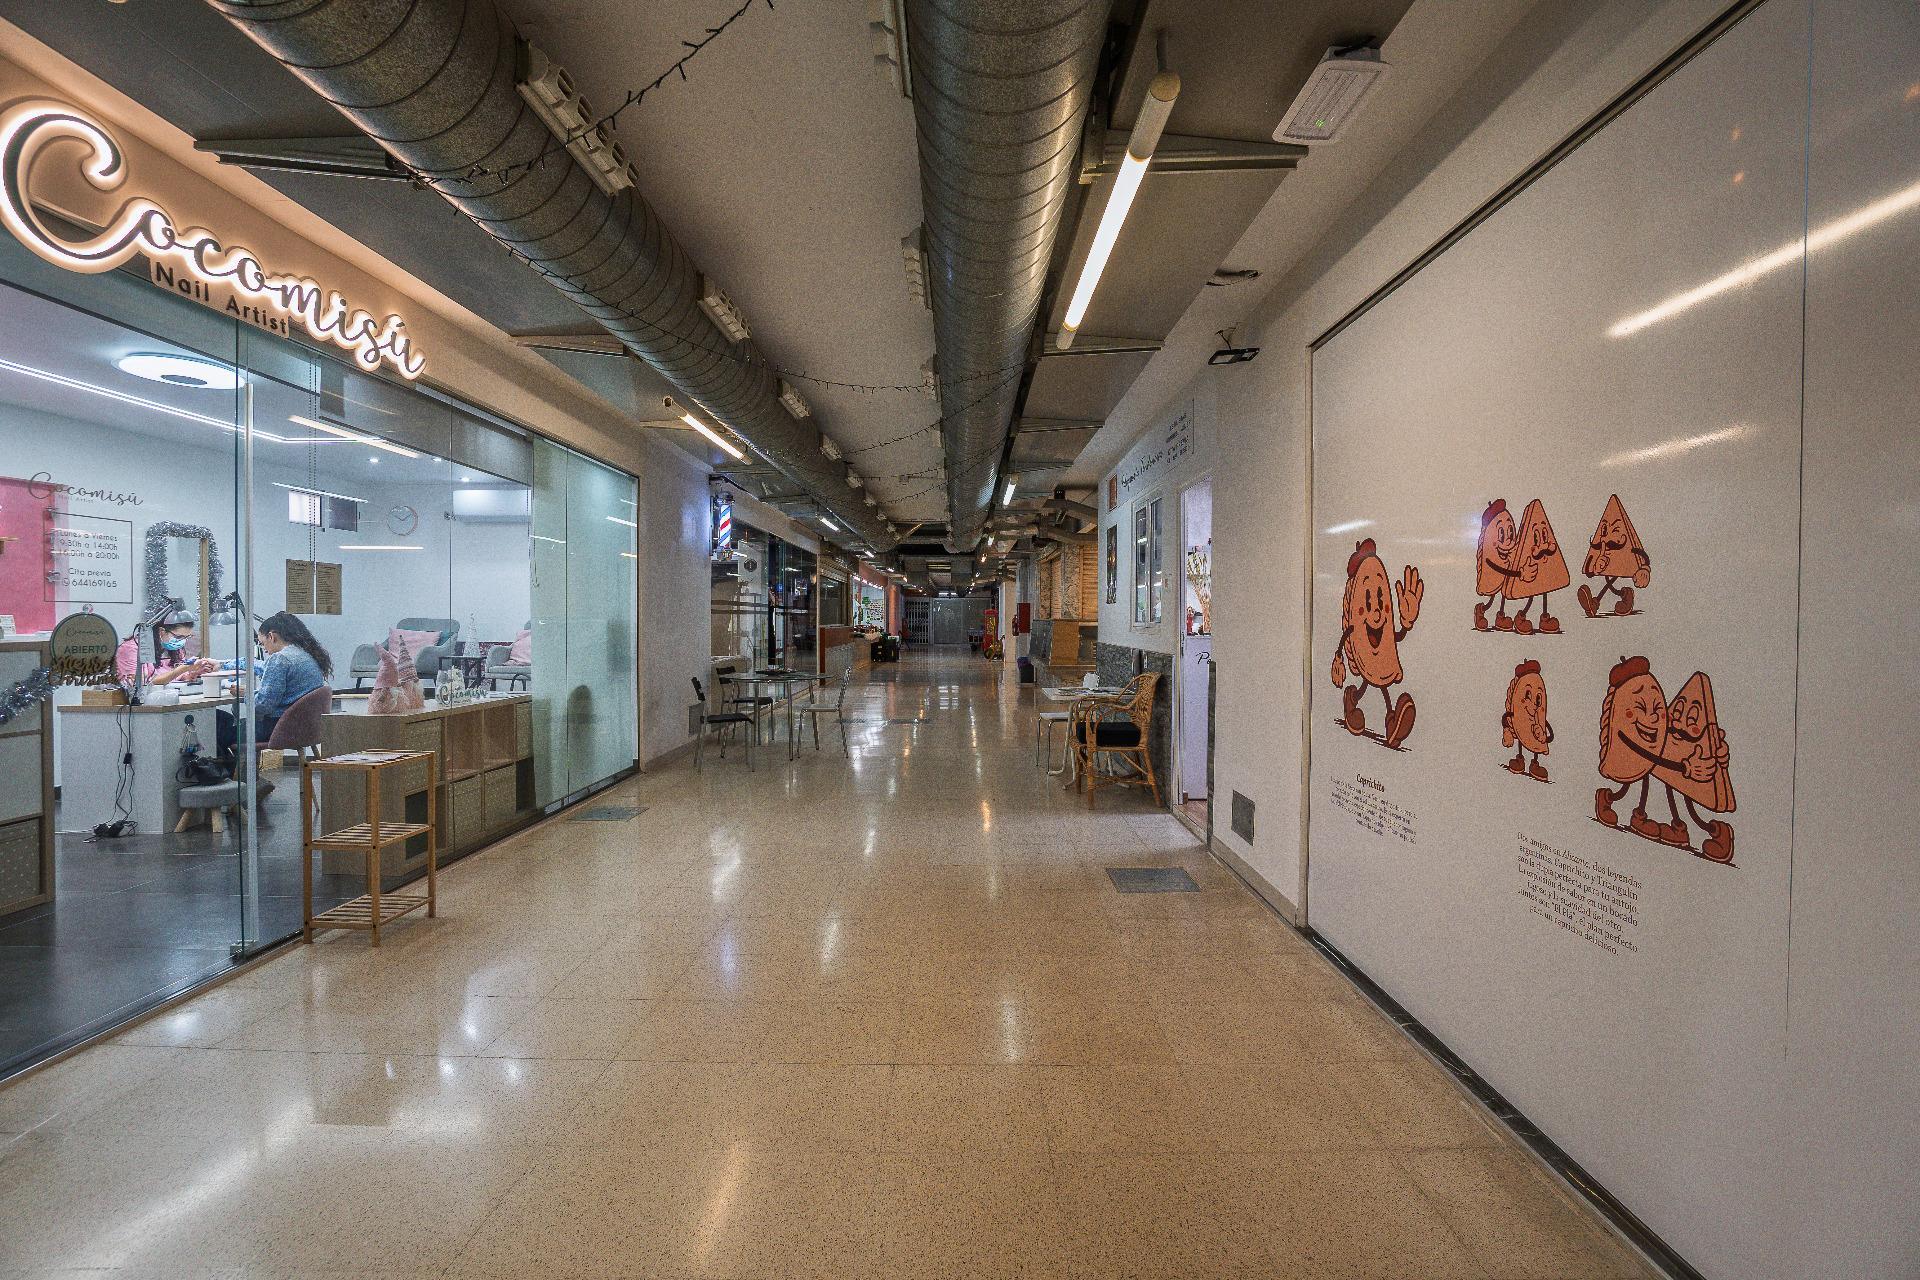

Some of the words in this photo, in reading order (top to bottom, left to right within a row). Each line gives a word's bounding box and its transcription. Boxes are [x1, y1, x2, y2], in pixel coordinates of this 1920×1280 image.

[154, 261, 210, 303] Nail
[226, 294, 289, 334] Artist
[60, 530, 82, 538] Lunes
[92, 533, 118, 542] Viernes
[94, 541, 118, 551] 14:00h
[95, 551, 120, 560] 20:00h
[69, 567, 85, 576] Cita
[71, 579, 118, 588] 644169165
[63, 644, 109, 655] ABIERTO
